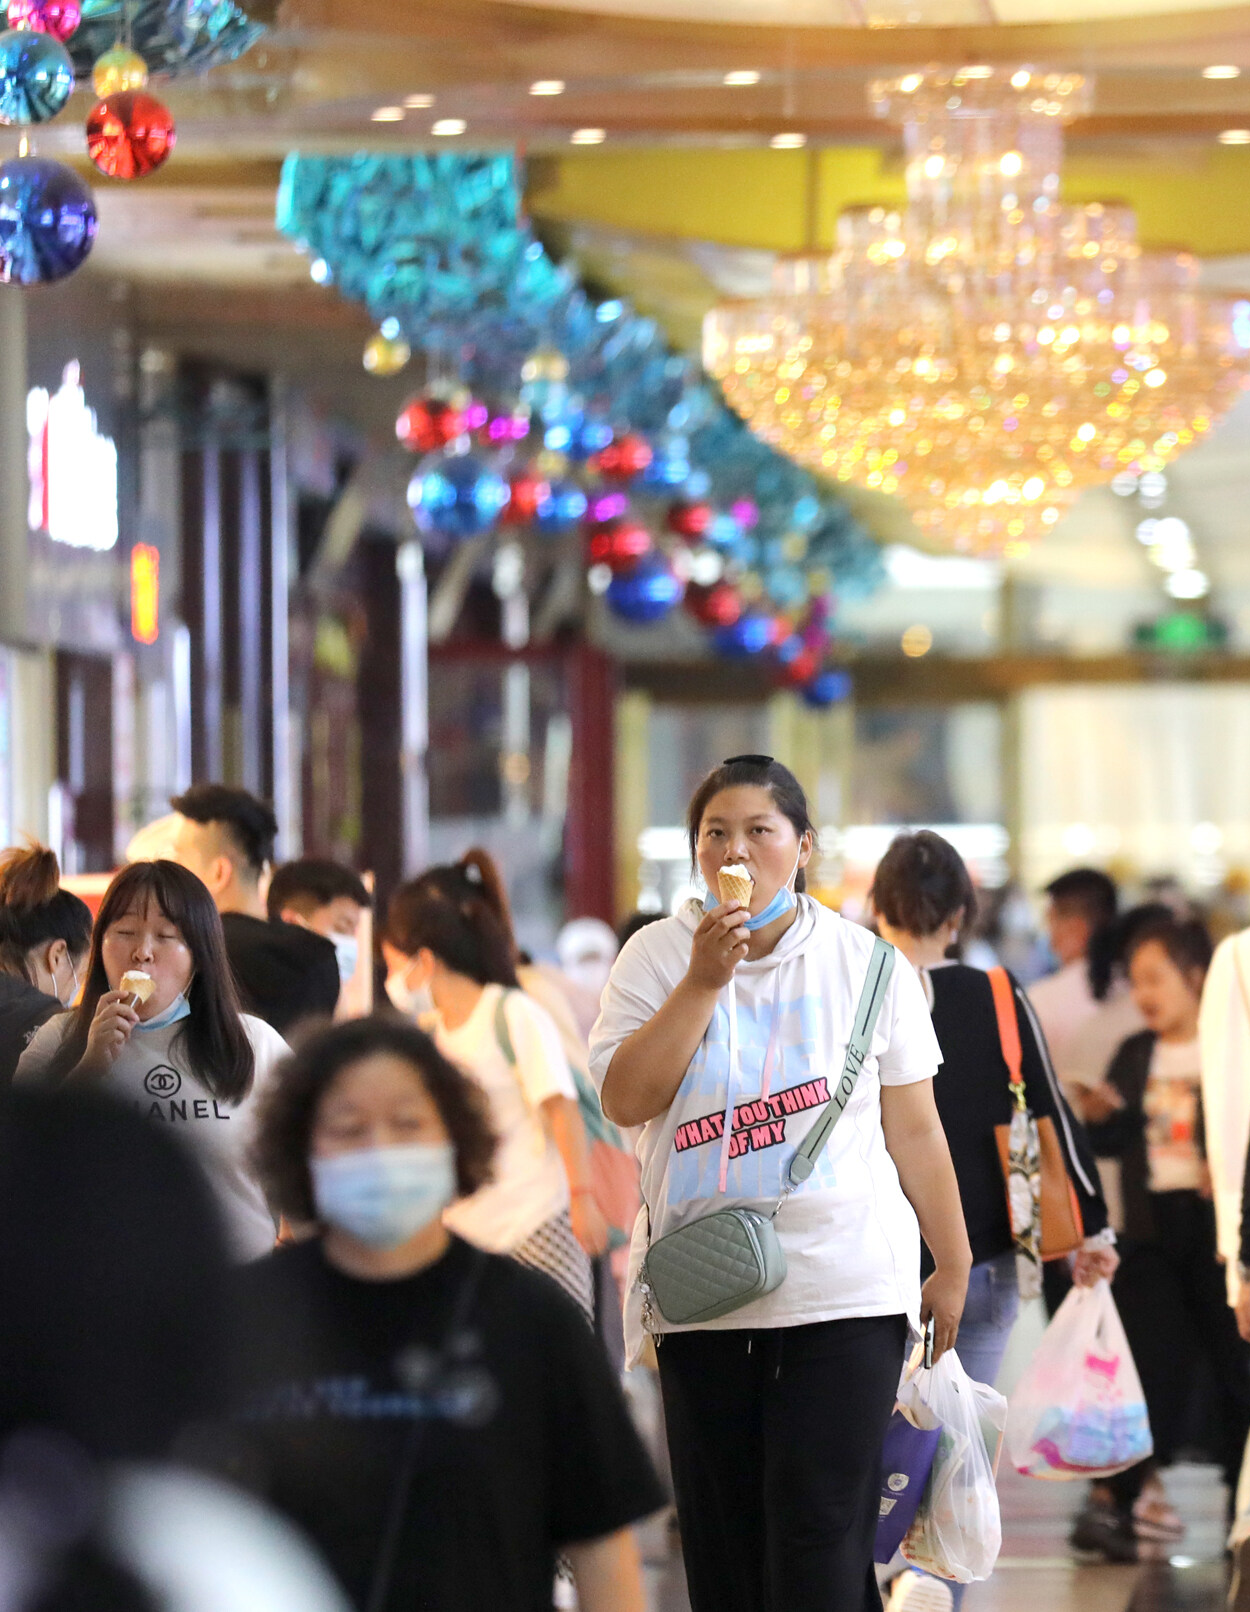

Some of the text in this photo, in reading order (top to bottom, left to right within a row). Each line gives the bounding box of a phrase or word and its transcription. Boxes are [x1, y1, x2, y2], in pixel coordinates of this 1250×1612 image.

[834, 1043, 866, 1112] LOVE
[133, 1098, 231, 1122] ANEL
[674, 1078, 832, 1152] WHAT YOU THINK
[727, 1119, 787, 1160] OF MY
